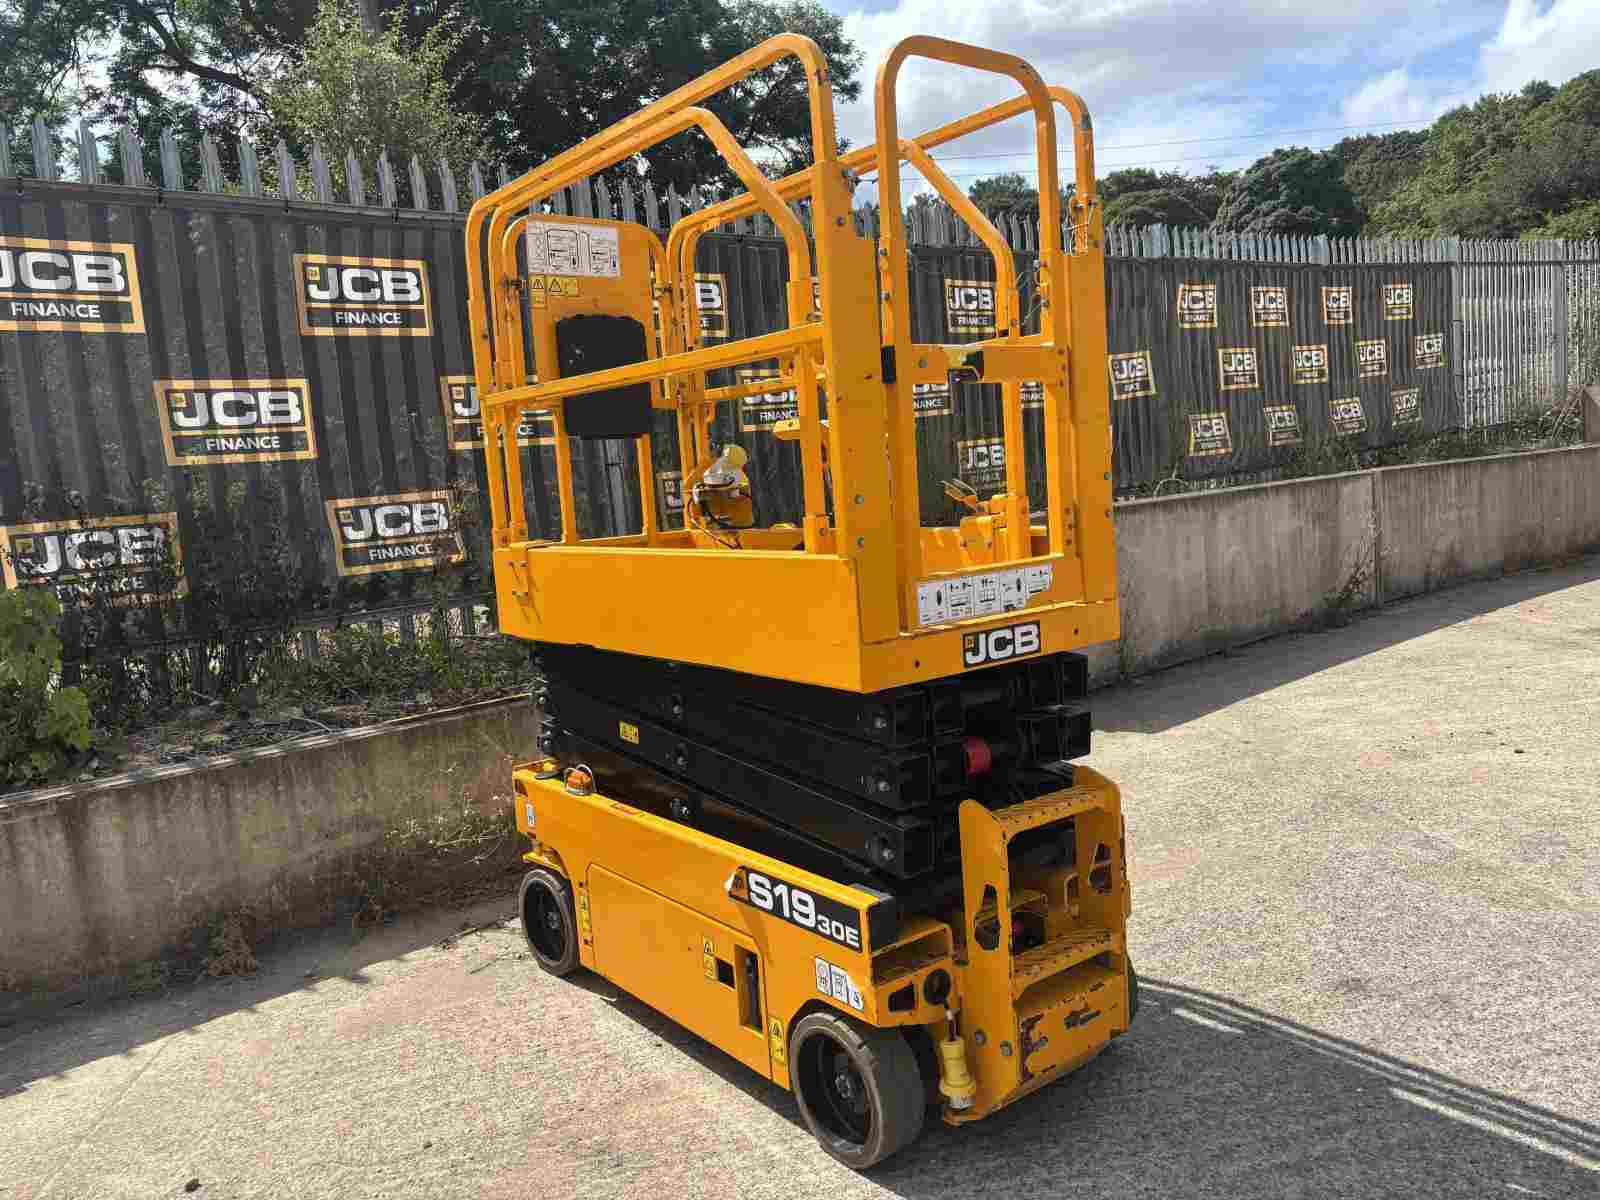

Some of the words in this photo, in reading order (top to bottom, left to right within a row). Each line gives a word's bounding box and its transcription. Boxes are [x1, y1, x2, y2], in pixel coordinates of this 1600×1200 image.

[308, 267, 421, 302] JCB
[951, 288, 993, 310] JCB
[1183, 290, 1214, 309] JCB
[1254, 291, 1284, 309] JCB
[1386, 288, 1411, 304] JCB
[11, 302, 101, 319] FINANCE
[335, 312, 403, 324] FINANCE
[1296, 351, 1324, 367] JCB
[1360, 344, 1385, 361] JCB
[1114, 358, 1147, 380] JCB
[1222, 353, 1255, 372] JCB
[172, 391, 302, 427] JCB
[1194, 418, 1225, 438] JCB
[206, 435, 281, 451] FINANCE
[342, 502, 449, 540] JCB
[368, 543, 433, 560] FINANCE
[966, 623, 1040, 664] JCB
